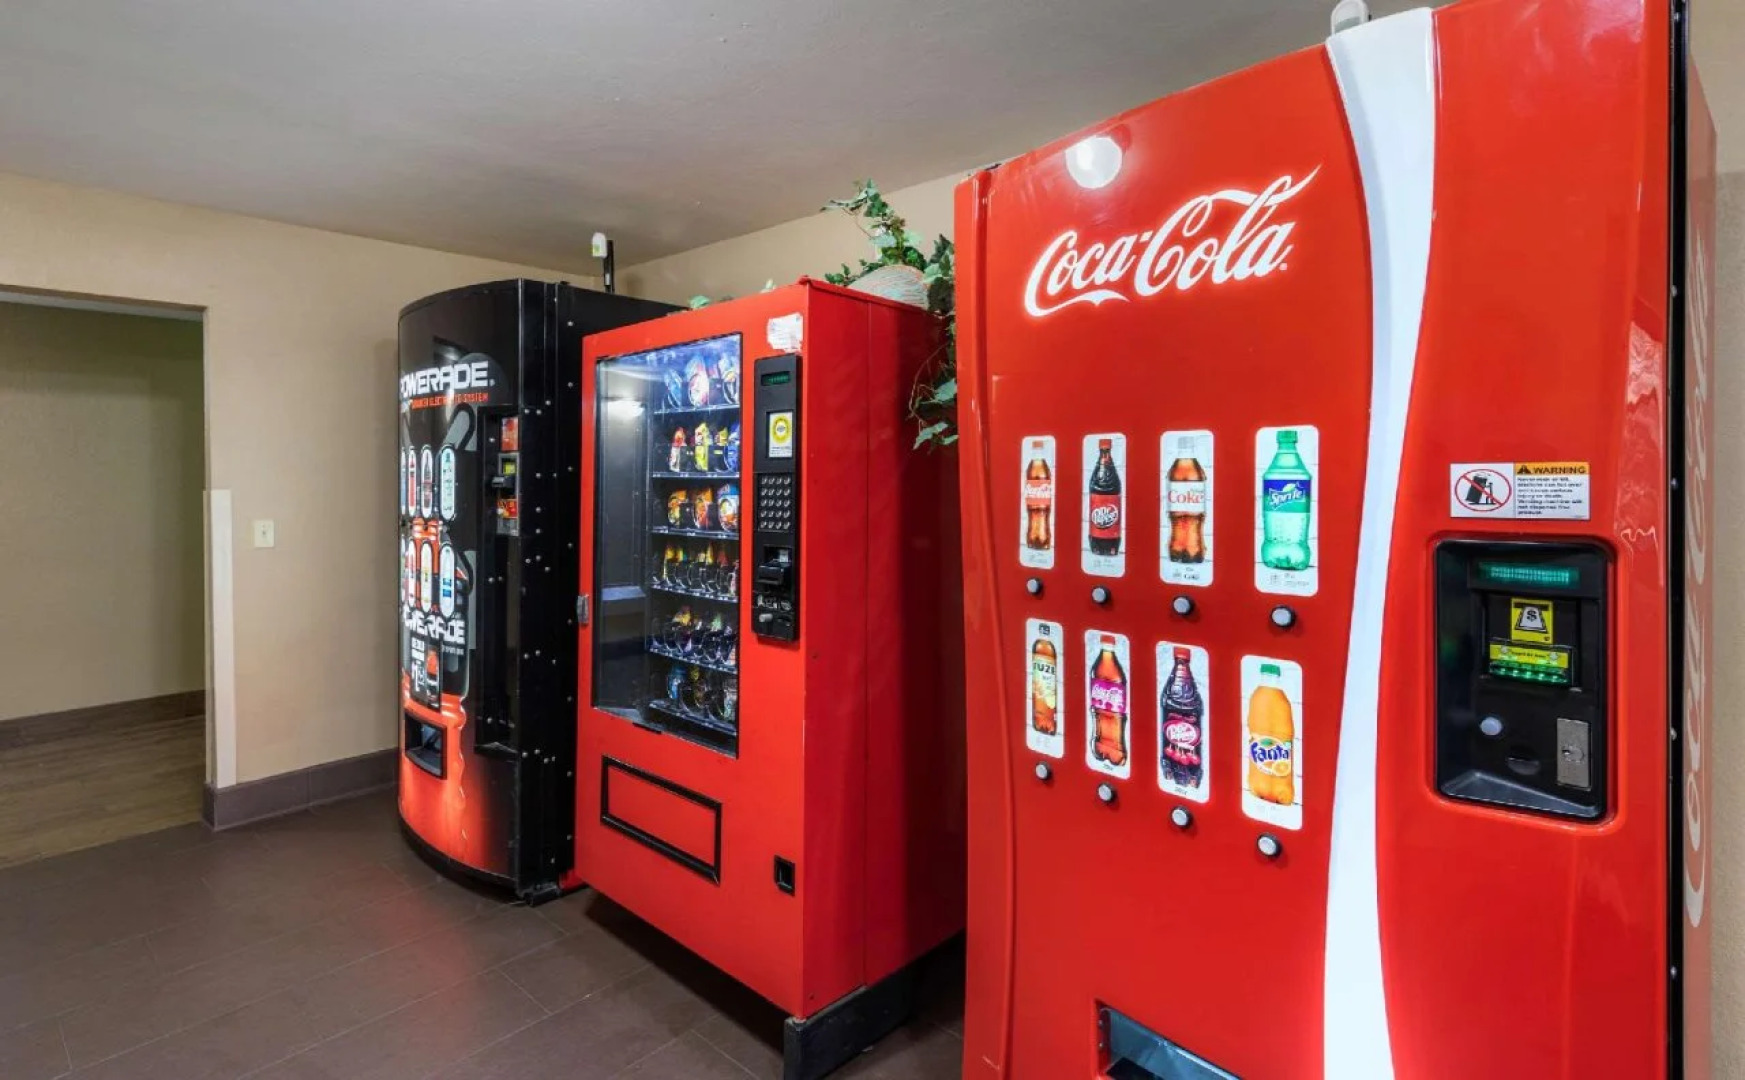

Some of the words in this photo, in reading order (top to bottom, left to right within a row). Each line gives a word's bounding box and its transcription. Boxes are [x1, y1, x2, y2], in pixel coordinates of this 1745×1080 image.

[1024, 164, 1322, 317] Coca-Cola
[1534, 466, 1587, 475] WARNING
[1168, 489, 1204, 504] Coke
[1270, 487, 1303, 507] Sprite
